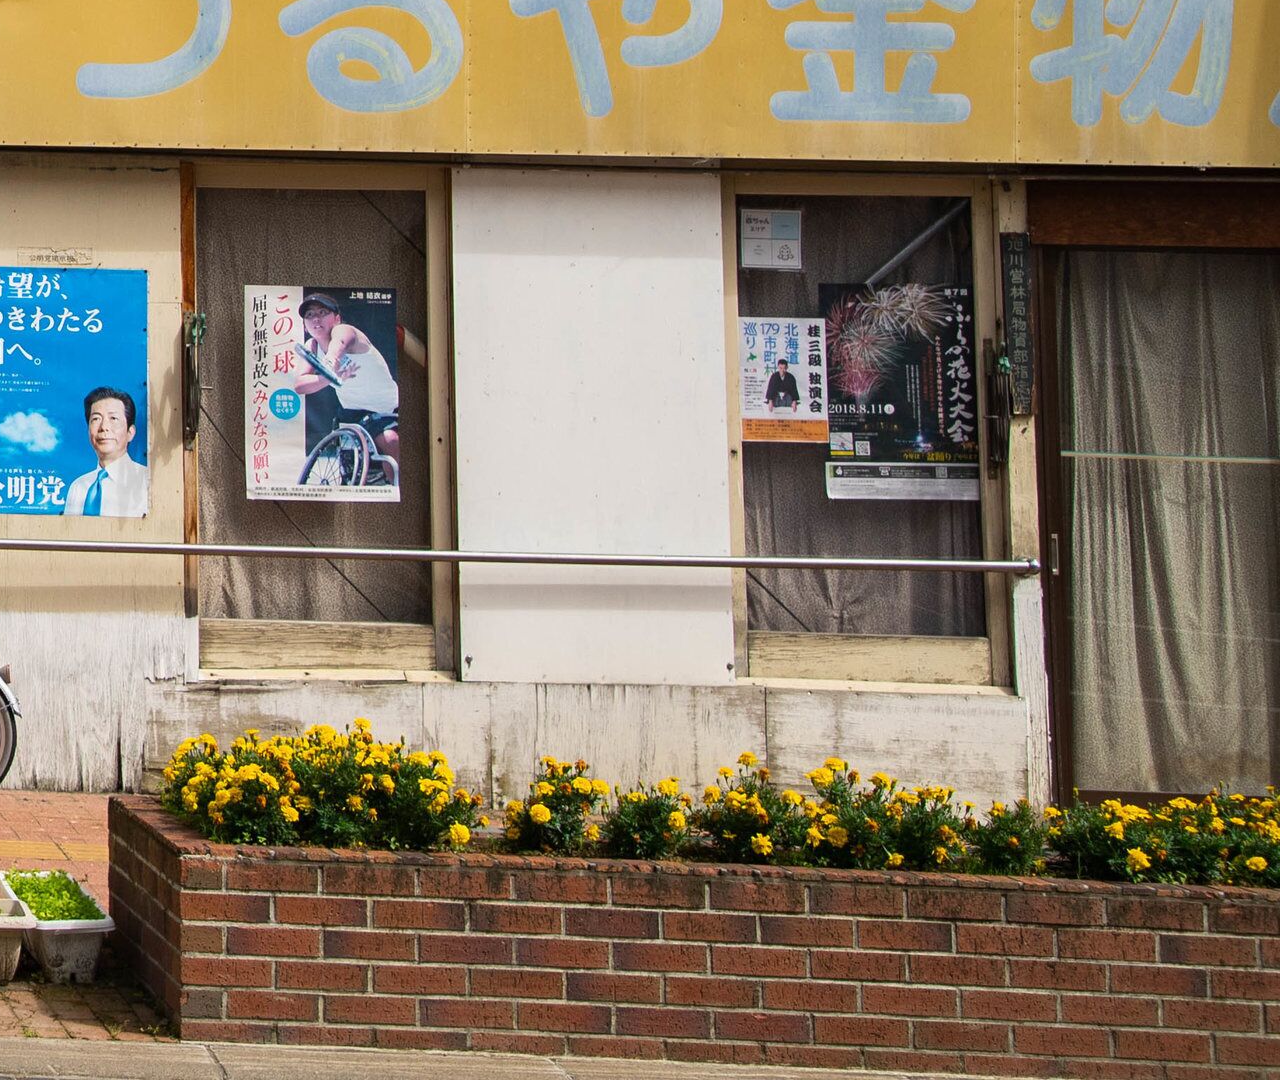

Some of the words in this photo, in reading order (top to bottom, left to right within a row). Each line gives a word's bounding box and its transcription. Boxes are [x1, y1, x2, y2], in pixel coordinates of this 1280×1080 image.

[273, 294, 296, 375] この一球
[743, 322, 757, 350] 巡り
[785, 324, 800, 365] 北海道
[828, 403, 885, 415] 2018.8.11
